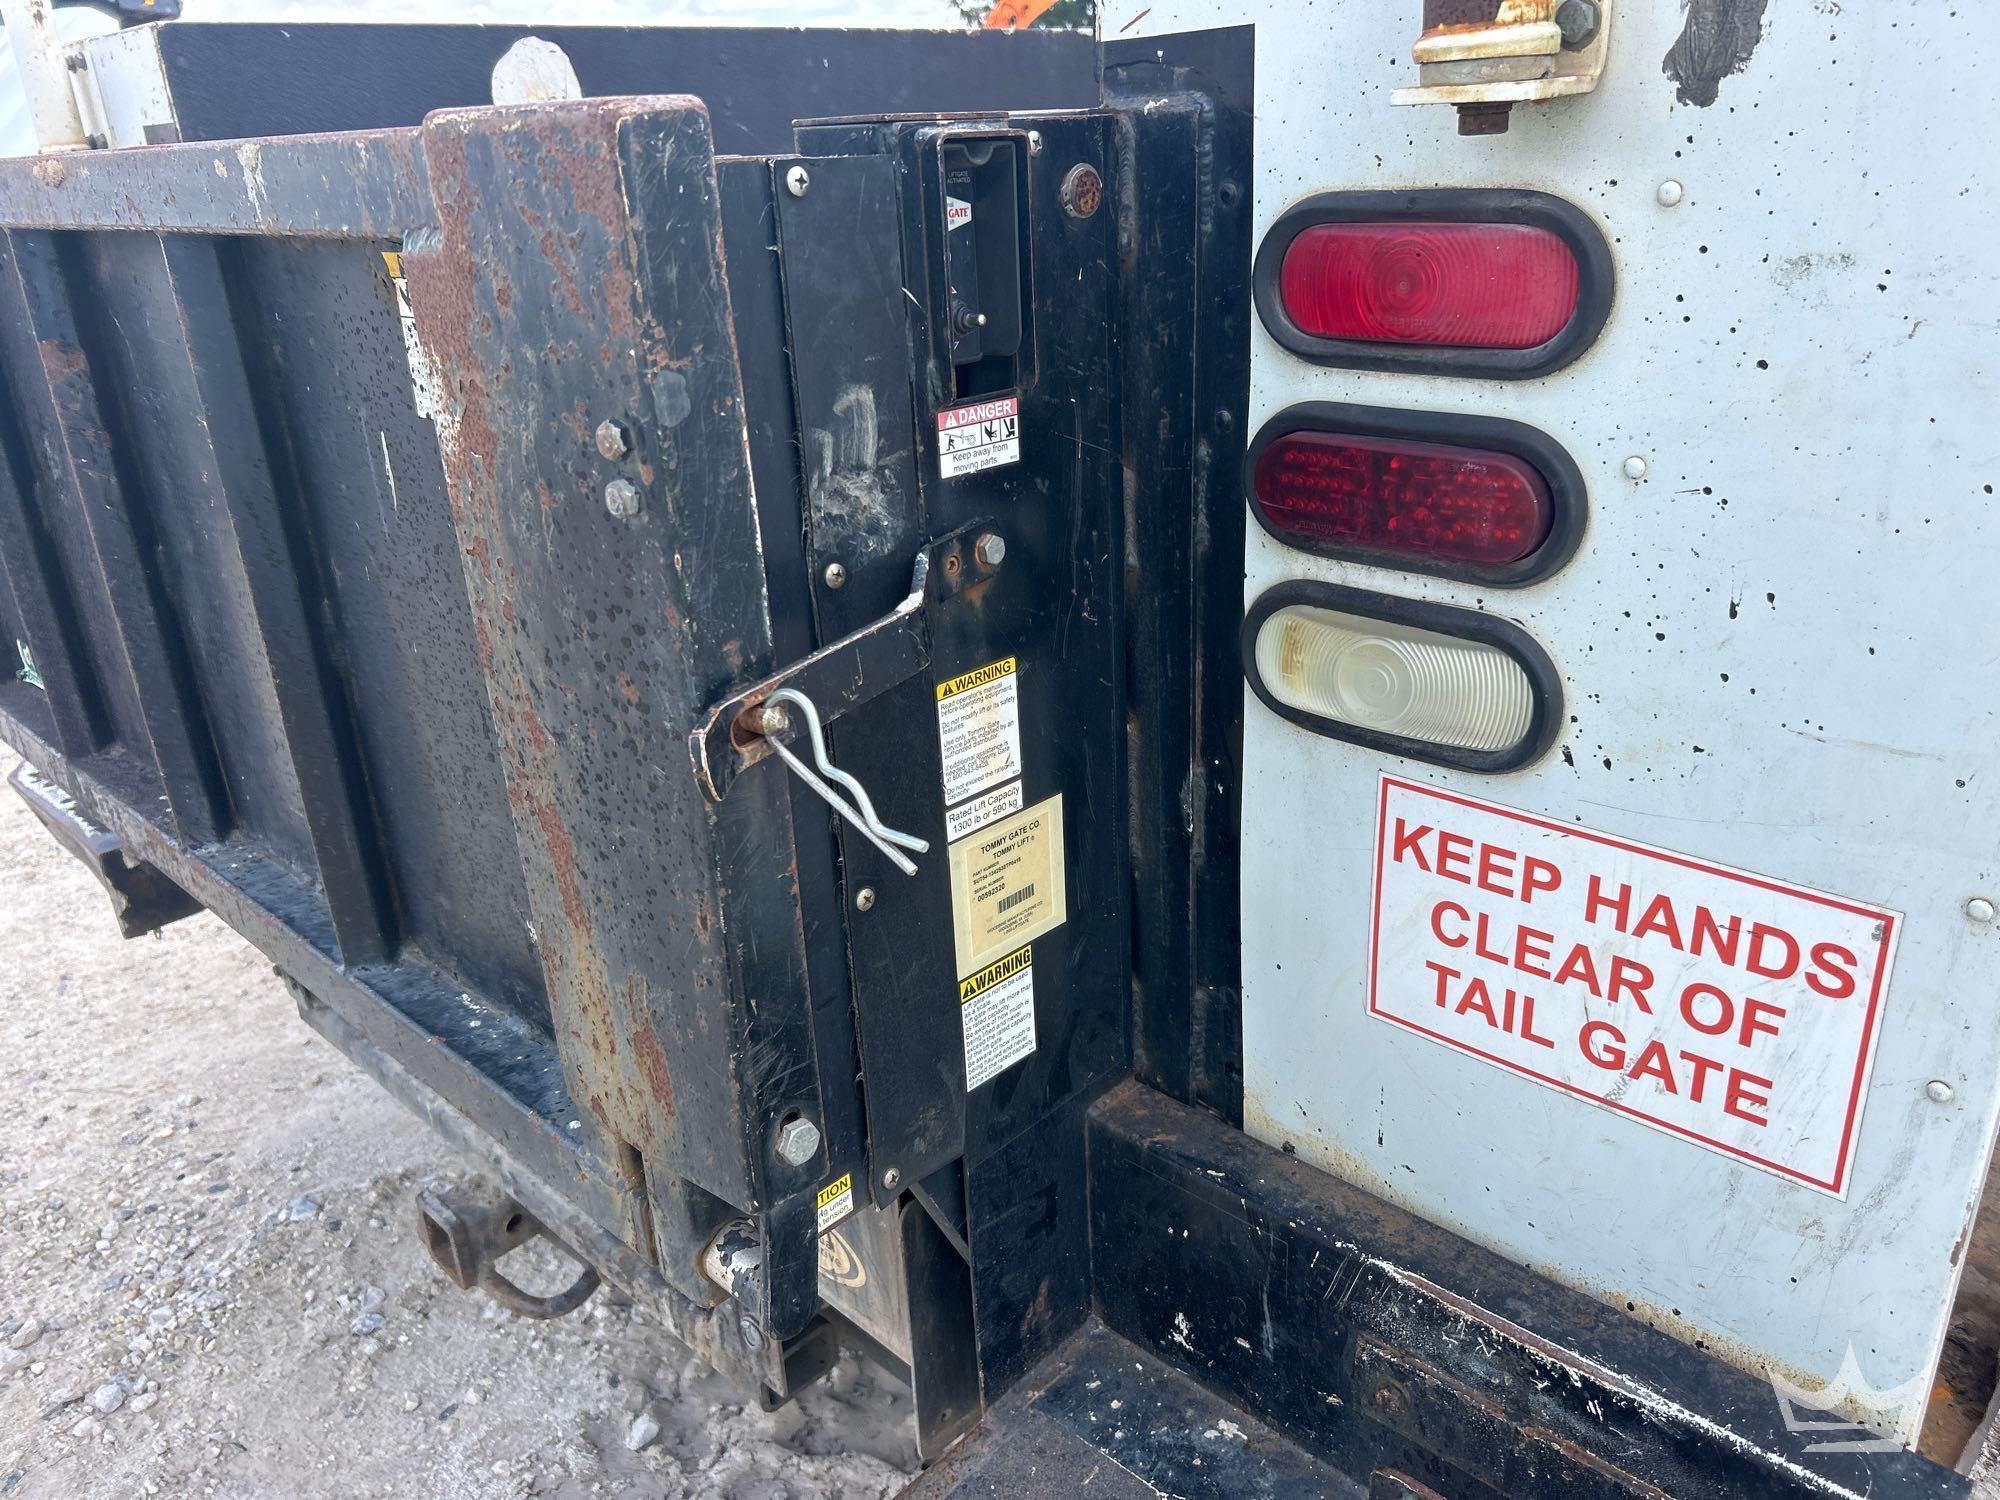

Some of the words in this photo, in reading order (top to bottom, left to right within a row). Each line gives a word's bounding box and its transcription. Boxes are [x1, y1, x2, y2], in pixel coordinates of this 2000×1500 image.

[949, 208, 968, 218] GATE
[958, 400, 1012, 424] DANGER
[952, 450, 971, 463] Keep
[972, 446, 991, 459] away
[992, 442, 1007, 452] from
[953, 460, 978, 473] moving
[980, 455, 997, 467] parts
[955, 661, 1011, 692] WARNING
[940, 699, 954, 710] Read
[956, 689, 982, 705] operator's
[983, 681, 1002, 693] manual
[941, 704, 958, 716] before
[959, 695, 983, 710] operating
[942, 720, 950, 729] Do
[950, 716, 959, 725] not
[960, 709, 978, 722] modify
[1000, 694, 1015, 706] safety
[943, 738, 954, 747] Use
[954, 733, 965, 743] only
[967, 724, 985, 737] Tommy
[987, 719, 999, 729] Gate
[943, 741, 963, 754] service
[963, 735, 977, 745] parts
[977, 725, 999, 739] installed
[1000, 722, 1006, 730] by
[1007, 719, 1013, 727] an
[944, 743, 972, 759] authorized
[949, 754, 975, 769] additional
[976, 742, 1003, 758] assistance
[967, 759, 976, 767] call
[978, 750, 996, 764] Tommy
[997, 744, 1009, 755] Gate
[947, 787, 954, 795] Do
[955, 782, 964, 791] not
[965, 774, 984, 787] exceed
[985, 770, 993, 778] the
[994, 763, 1008, 774] rated
[948, 805, 971, 823] Rated
[974, 799, 985, 812] Lift
[987, 783, 1019, 807] Capacity
[953, 817, 972, 833] 1300
[973, 813, 981, 824] lb
[982, 810, 991, 819] or
[992, 801, 1006, 815] 590
[1008, 797, 1017, 810] kg
[981, 836, 1006, 854] TOMMY
[1008, 825, 1027, 840] GATE
[993, 843, 1015, 859] TOMMY
[1017, 835, 1029, 847] LIFT
[977, 882, 1005, 902] 00592320
[1393, 817, 1562, 904] KEEP
[1584, 874, 1858, 999] HANDS
[975, 948, 1031, 991] WARNING
[1430, 900, 1655, 1014] CLEAR
[1680, 981, 1787, 1049] OF
[963, 1001, 972, 1011] Lift
[972, 995, 985, 1008] gate
[991, 986, 1000, 995] not
[1007, 977, 1014, 986] be
[1015, 970, 1027, 981] used
[964, 1016, 972, 1025] Lift
[973, 1009, 986, 1022] gate
[986, 1002, 998, 1013] may
[1006, 989, 1019, 1001] more
[1020, 982, 1031, 992] than
[965, 1030, 973, 1040] Be
[974, 1021, 990, 1035] aware
[997, 1010, 1008, 1021] how
[1009, 1000, 1023, 1014] much
[966, 1034, 981, 1048] being
[982, 1024, 995, 1037] lifted
[995, 1018, 1006, 1029] and
[1007, 1010, 1021, 1022] never
[966, 1038, 985, 1054] exceed
[986, 1032, 995, 1042] the
[996, 1024, 1009, 1036] rated
[1010, 1010, 1031, 1029] capacity
[972, 1016, 986, 1028] rated
[968, 1062, 983, 1076] being
[983, 1050, 1001, 1065] hauled
[1002, 1043, 1012, 1054] and
[1013, 1034, 1027, 1047] never
[968, 1066, 987, 1082] exceed
[988, 1060, 996, 1070] the
[997, 1051, 1011, 1063] rated
[1012, 1037, 1032, 1056] capacity
[973, 1048, 981, 1057] the
[976, 1049, 992, 1064] aware
[999, 1038, 1010, 1049] how
[1010, 1028, 1024, 1041] much
[1425, 960, 1556, 1050] TAIL
[1578, 1019, 1774, 1128] GATE
[975, 1075, 983, 1084] the
[830, 1194, 850, 1210] under
